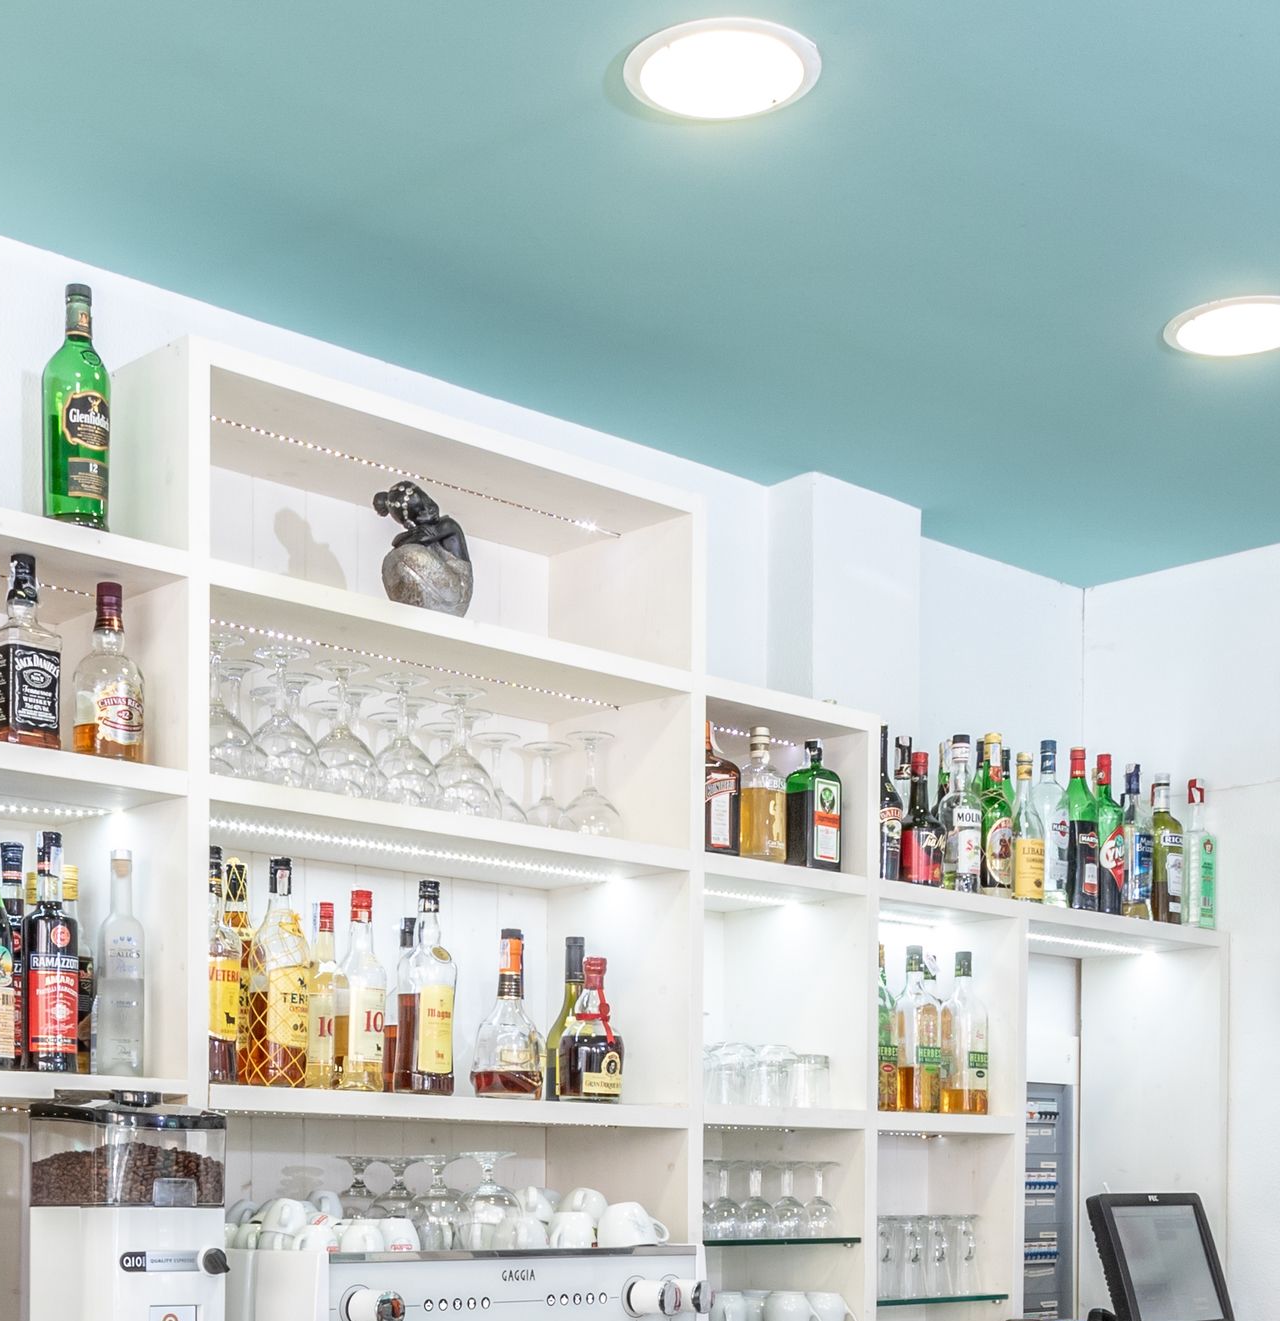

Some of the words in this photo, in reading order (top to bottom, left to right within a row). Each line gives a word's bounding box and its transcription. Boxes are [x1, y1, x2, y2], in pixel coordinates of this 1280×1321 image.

[88, 463, 98, 473] 12
[15, 654, 34, 671] JACK
[99, 696, 124, 708] CHIVAS
[501, 1269, 536, 1282] GAGGIA
